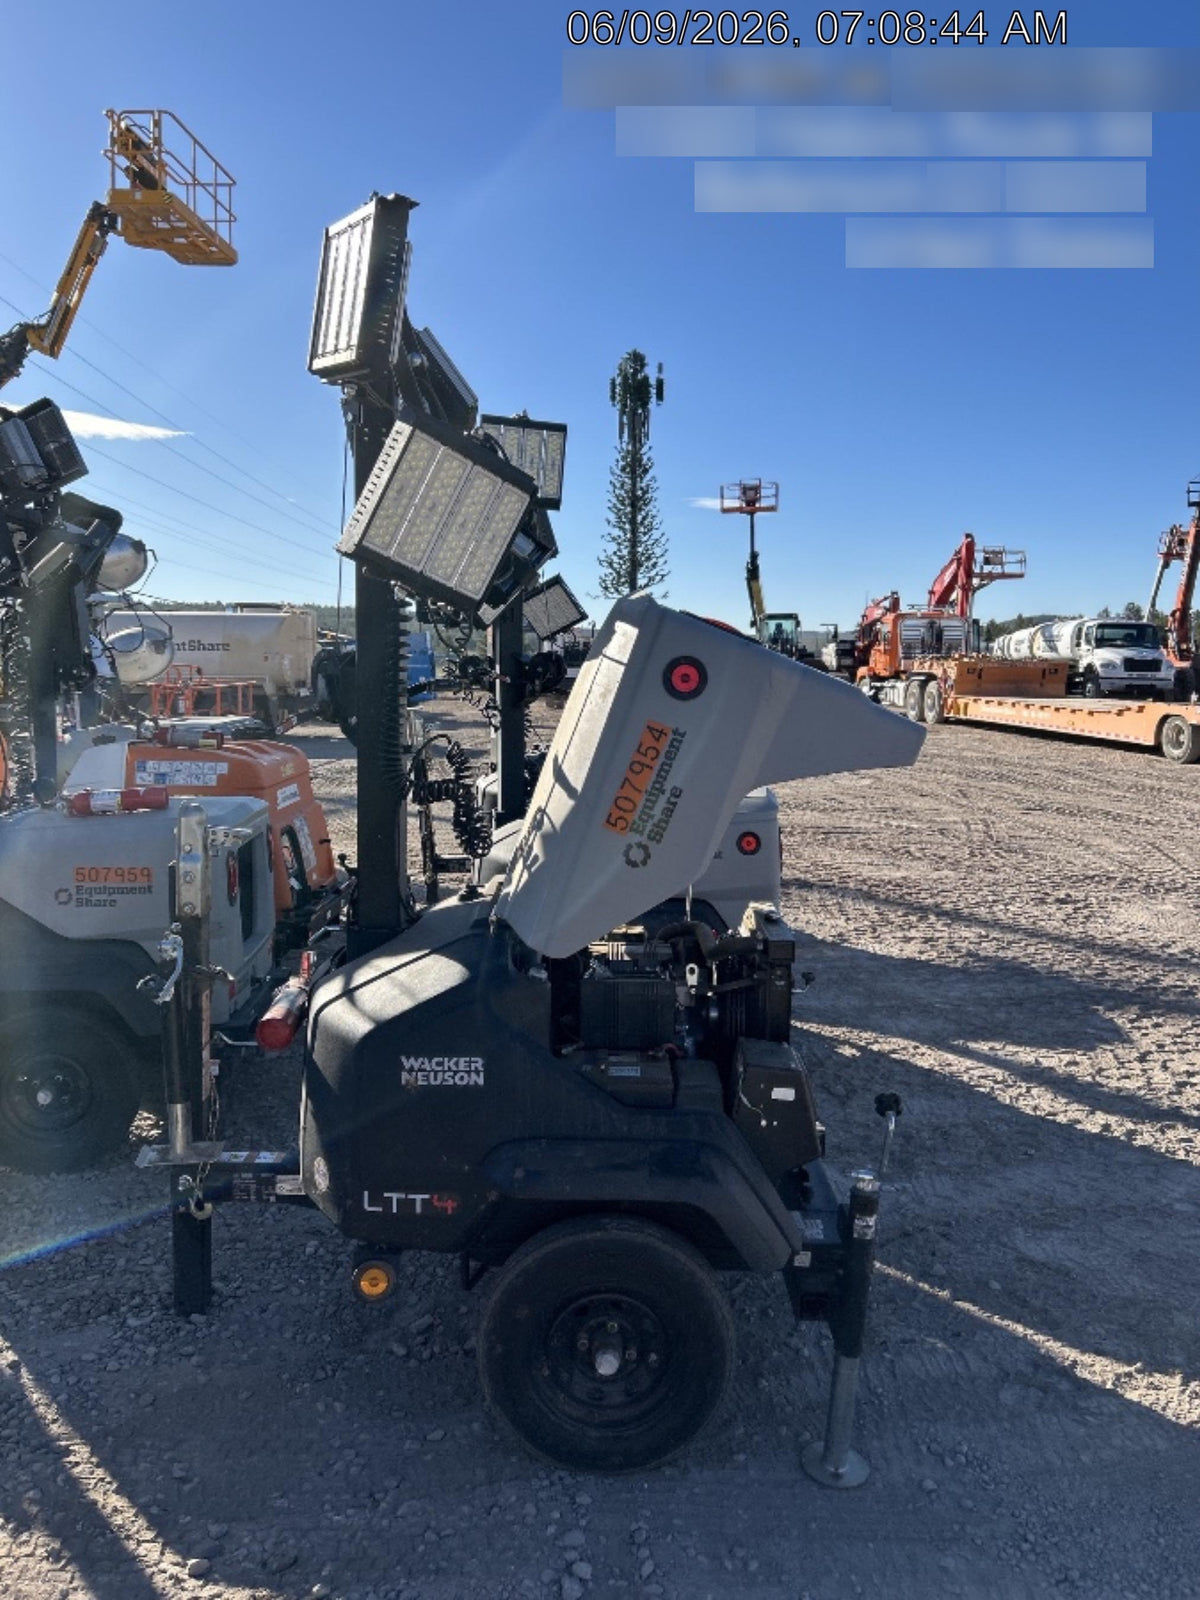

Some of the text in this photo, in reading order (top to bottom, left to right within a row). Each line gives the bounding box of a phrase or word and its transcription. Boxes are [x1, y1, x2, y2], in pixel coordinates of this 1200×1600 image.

[605, 724, 668, 832] 507954
[629, 727, 687, 836] Equipment
[647, 786, 683, 844] Share
[75, 867, 151, 883] 507959
[75, 885, 153, 898] Equipment
[75, 897, 118, 907] Share
[400, 1056, 485, 1071] WACKER
[401, 1071, 485, 1086] NEUSON
[363, 1190, 457, 1215] LTT4
